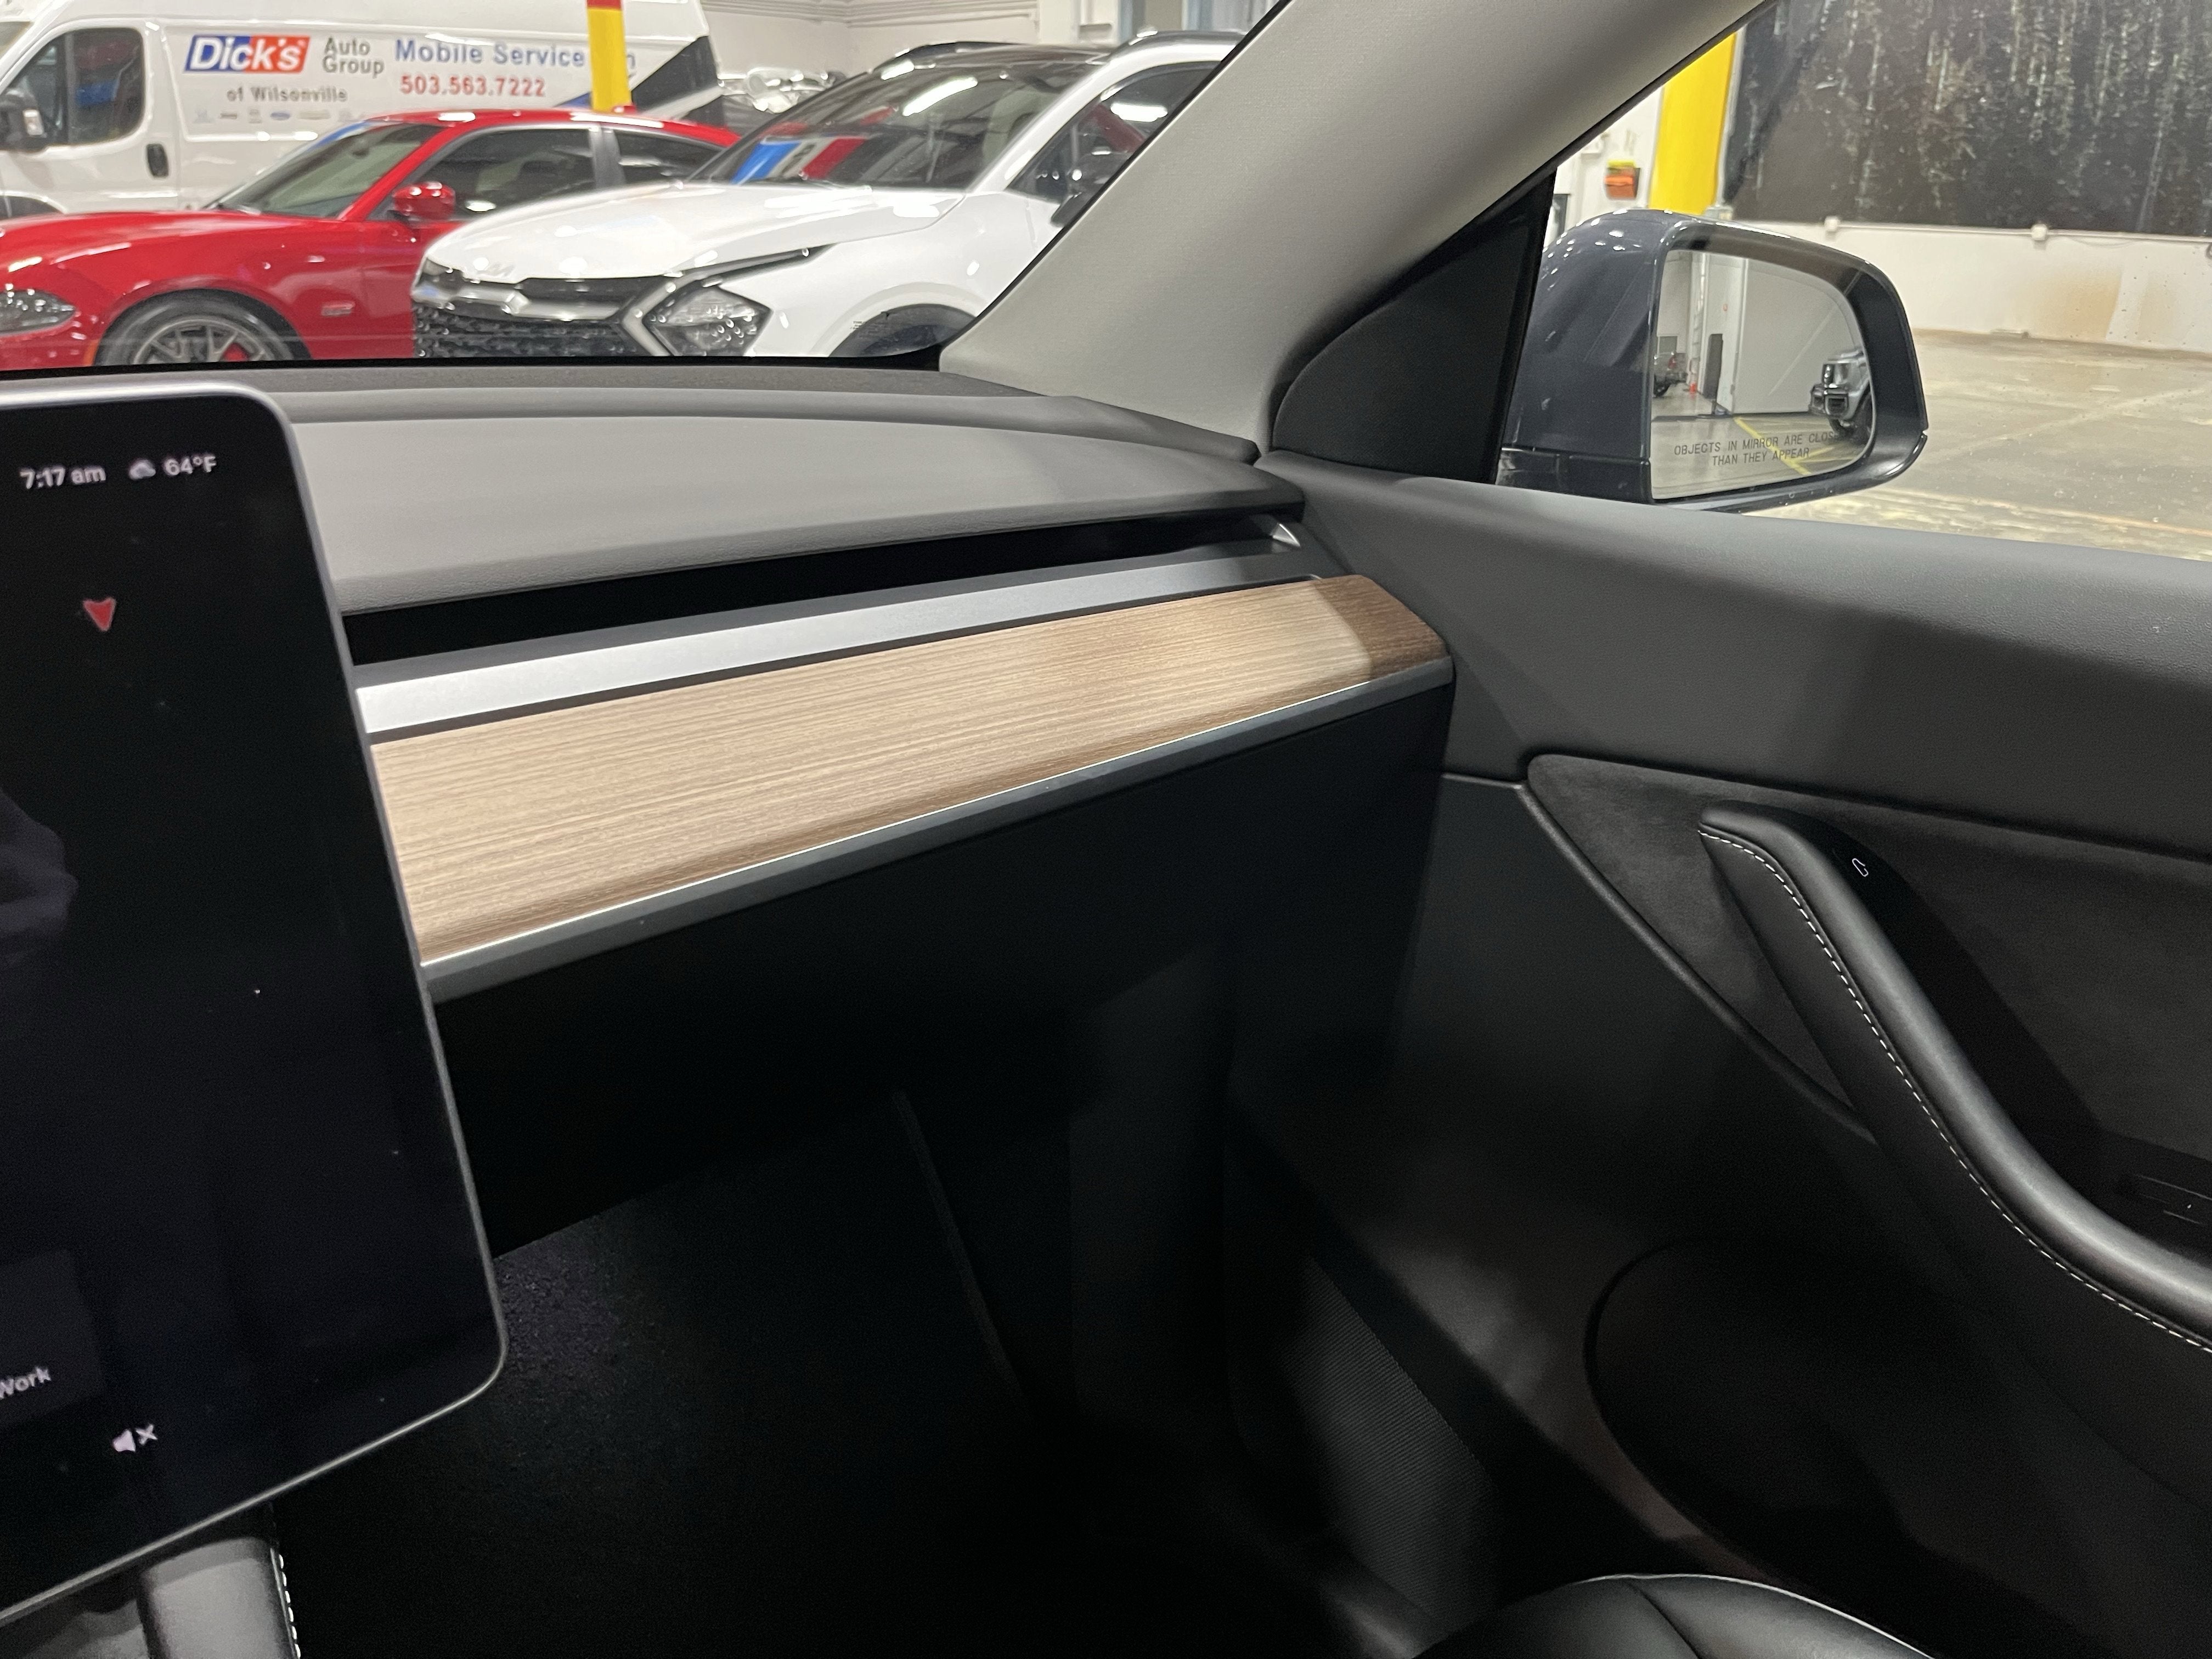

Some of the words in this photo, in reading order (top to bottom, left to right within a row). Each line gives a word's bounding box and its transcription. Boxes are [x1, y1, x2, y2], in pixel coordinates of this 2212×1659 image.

[190, 36, 301, 71] Dick's
[324, 37, 371, 57] Auto
[394, 38, 483, 64] Mobile
[494, 41, 585, 66] Service
[323, 56, 385, 78] Group
[227, 88, 244, 102] of
[251, 86, 348, 103] Wilsonville
[401, 74, 545, 97] 503.563.7222
[1674, 442, 1721, 455] OBJECTS
[1728, 439, 1738, 451] IN
[1742, 437, 1779, 449] MIRROR
[1784, 434, 1803, 445] ARE
[164, 455, 217, 476] 64°F
[1712, 453, 1738, 466] THAN
[1743, 450, 1768, 463] THEY
[1773, 447, 1810, 460] APPEAR
[20, 466, 66, 489] 7:17
[71, 465, 106, 484] am
